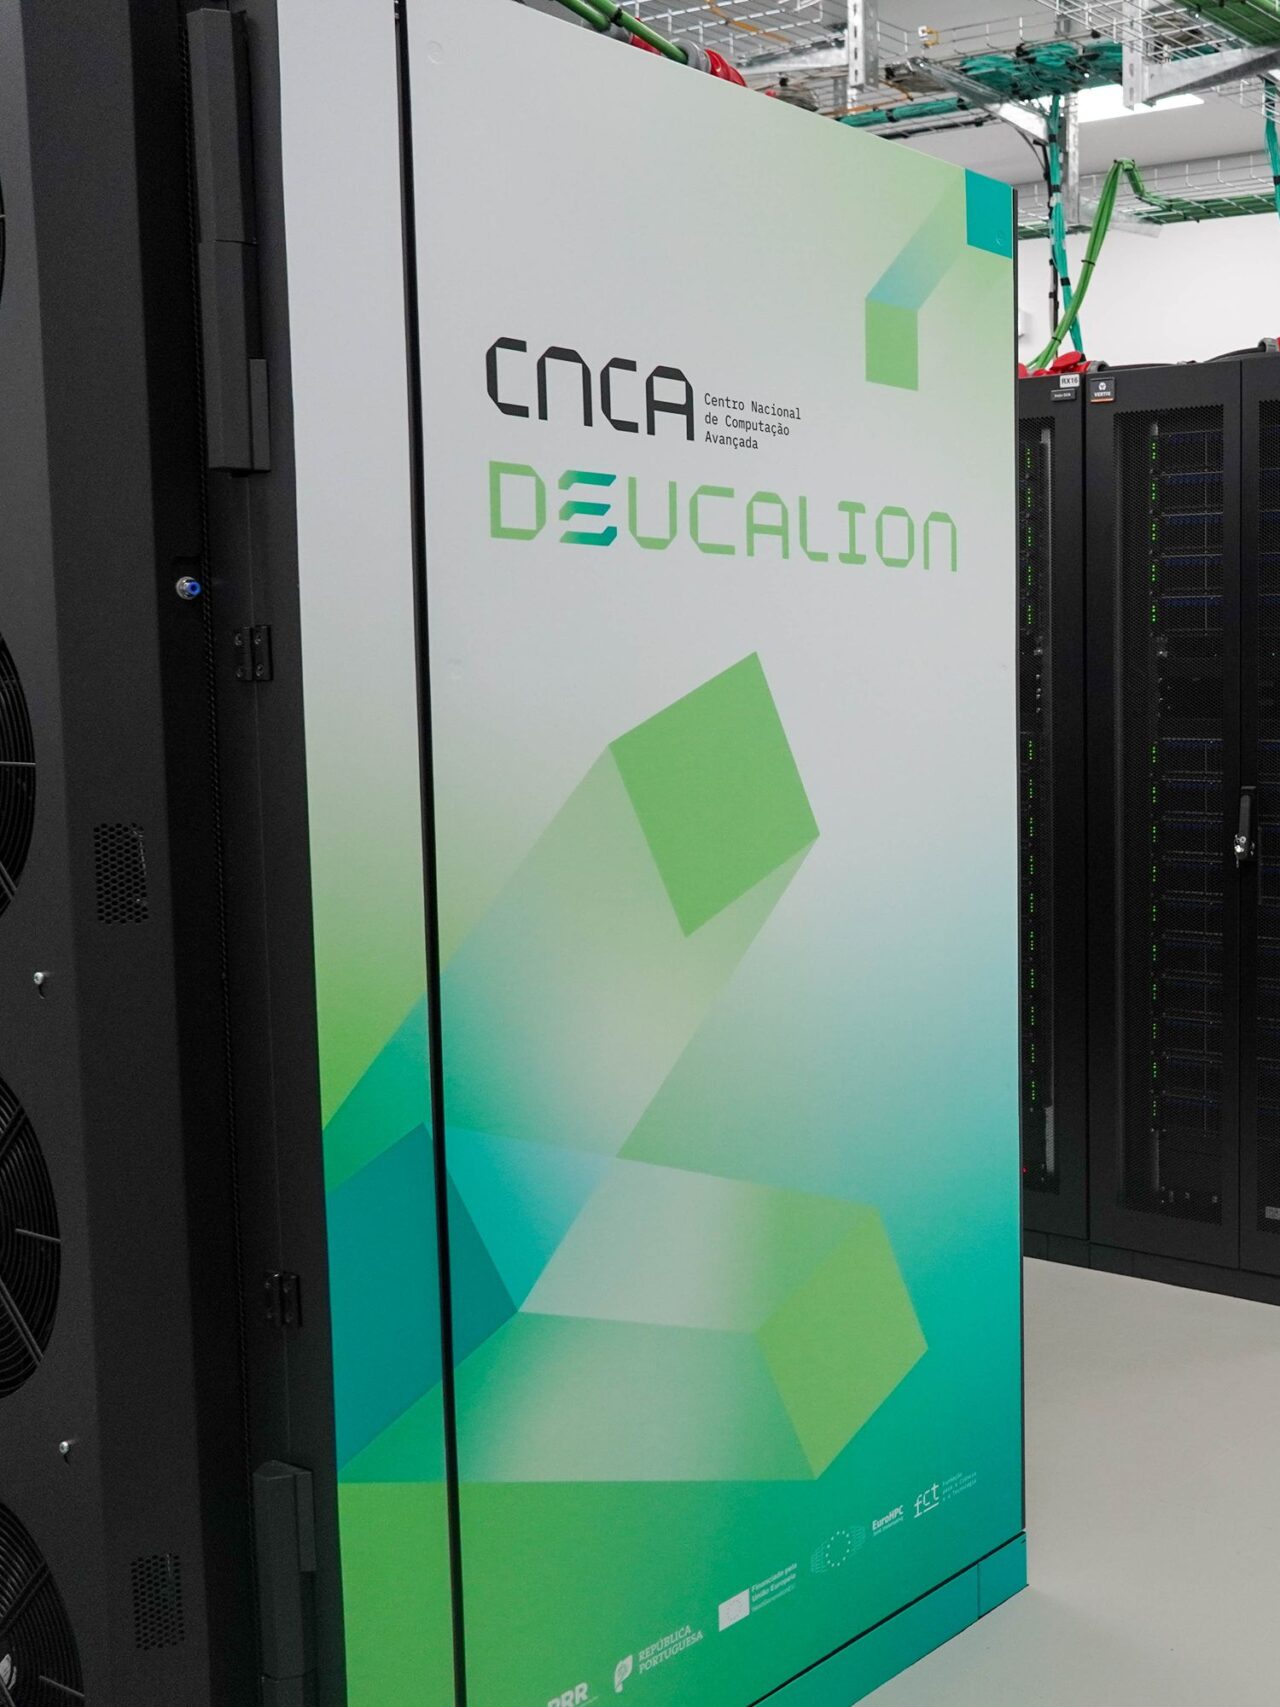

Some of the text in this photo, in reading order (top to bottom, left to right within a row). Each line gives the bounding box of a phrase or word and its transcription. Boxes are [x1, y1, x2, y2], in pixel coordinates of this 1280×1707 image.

[486, 336, 695, 441] CNCA
[704, 392, 801, 420] Centro Nacional
[704, 412, 790, 437] de Computação
[704, 431, 758, 450] Avançada
[489, 460, 958, 573] DEUCALION
[872, 1504, 904, 1531] EuroHPC
[638, 1624, 692, 1662] REPÚBLICA
[638, 1630, 704, 1675] PORTUGUESA
